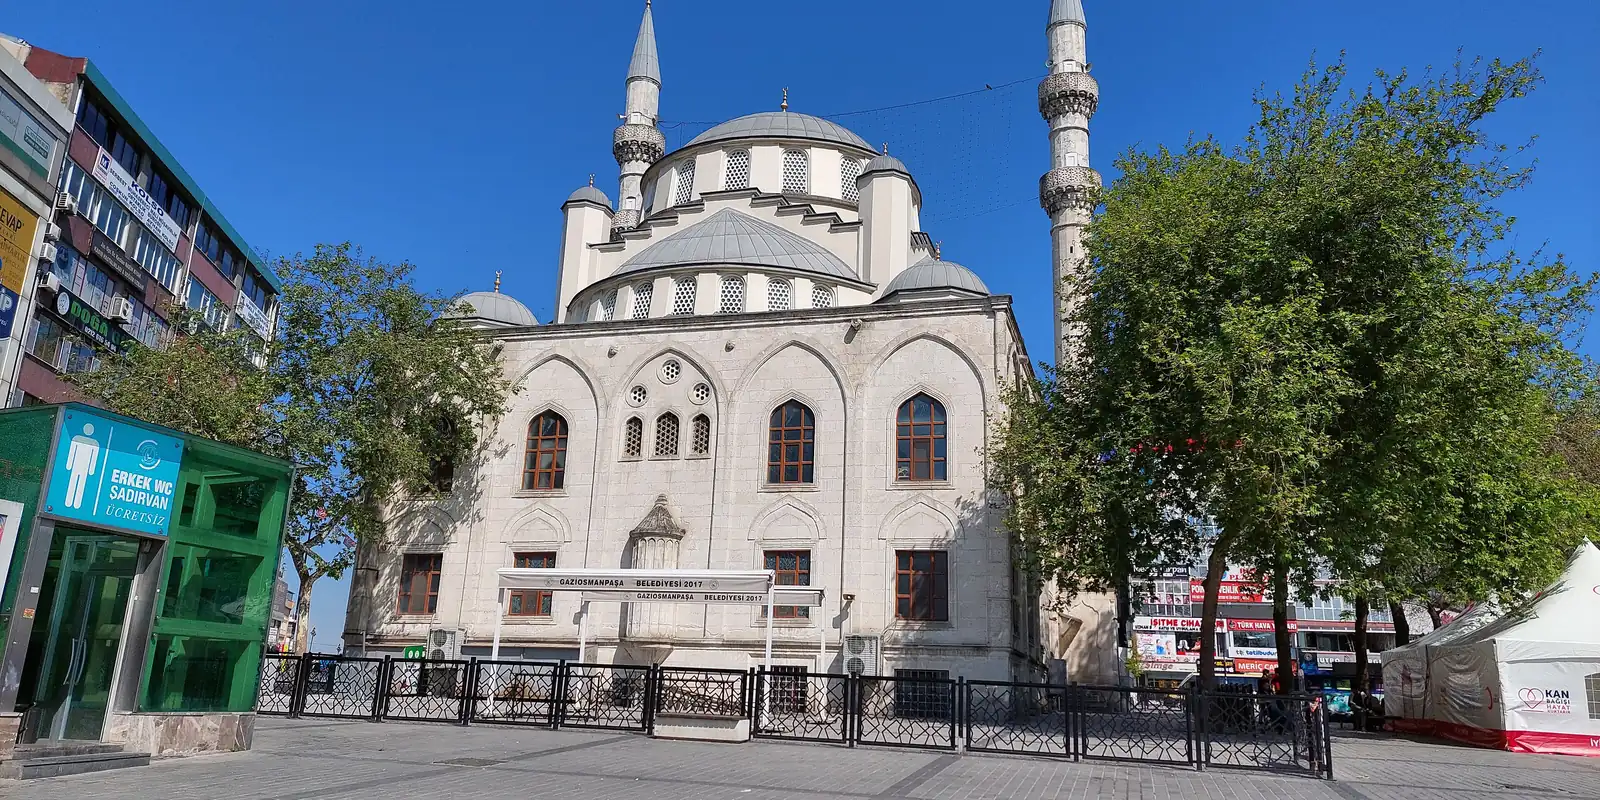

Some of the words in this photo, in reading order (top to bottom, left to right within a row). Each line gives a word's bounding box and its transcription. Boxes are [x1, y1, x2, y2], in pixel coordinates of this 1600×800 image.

[131, 180, 164, 217] KOLSO
[70, 300, 108, 337] DOĞA
[111, 469, 152, 491] ERKEK
[154, 479, 172, 496] WC
[109, 485, 168, 510] ŞADIRVAN
[106, 504, 165, 526] ÜCRETSİZ
[559, 578, 624, 588] GAZİOSMANPAŞA
[636, 579, 682, 588] BELEDİYESİ
[1237, 621, 1254, 629] TÜRK
[1238, 661, 1263, 671] MERİÇ
[1545, 689, 1569, 699] KAN
